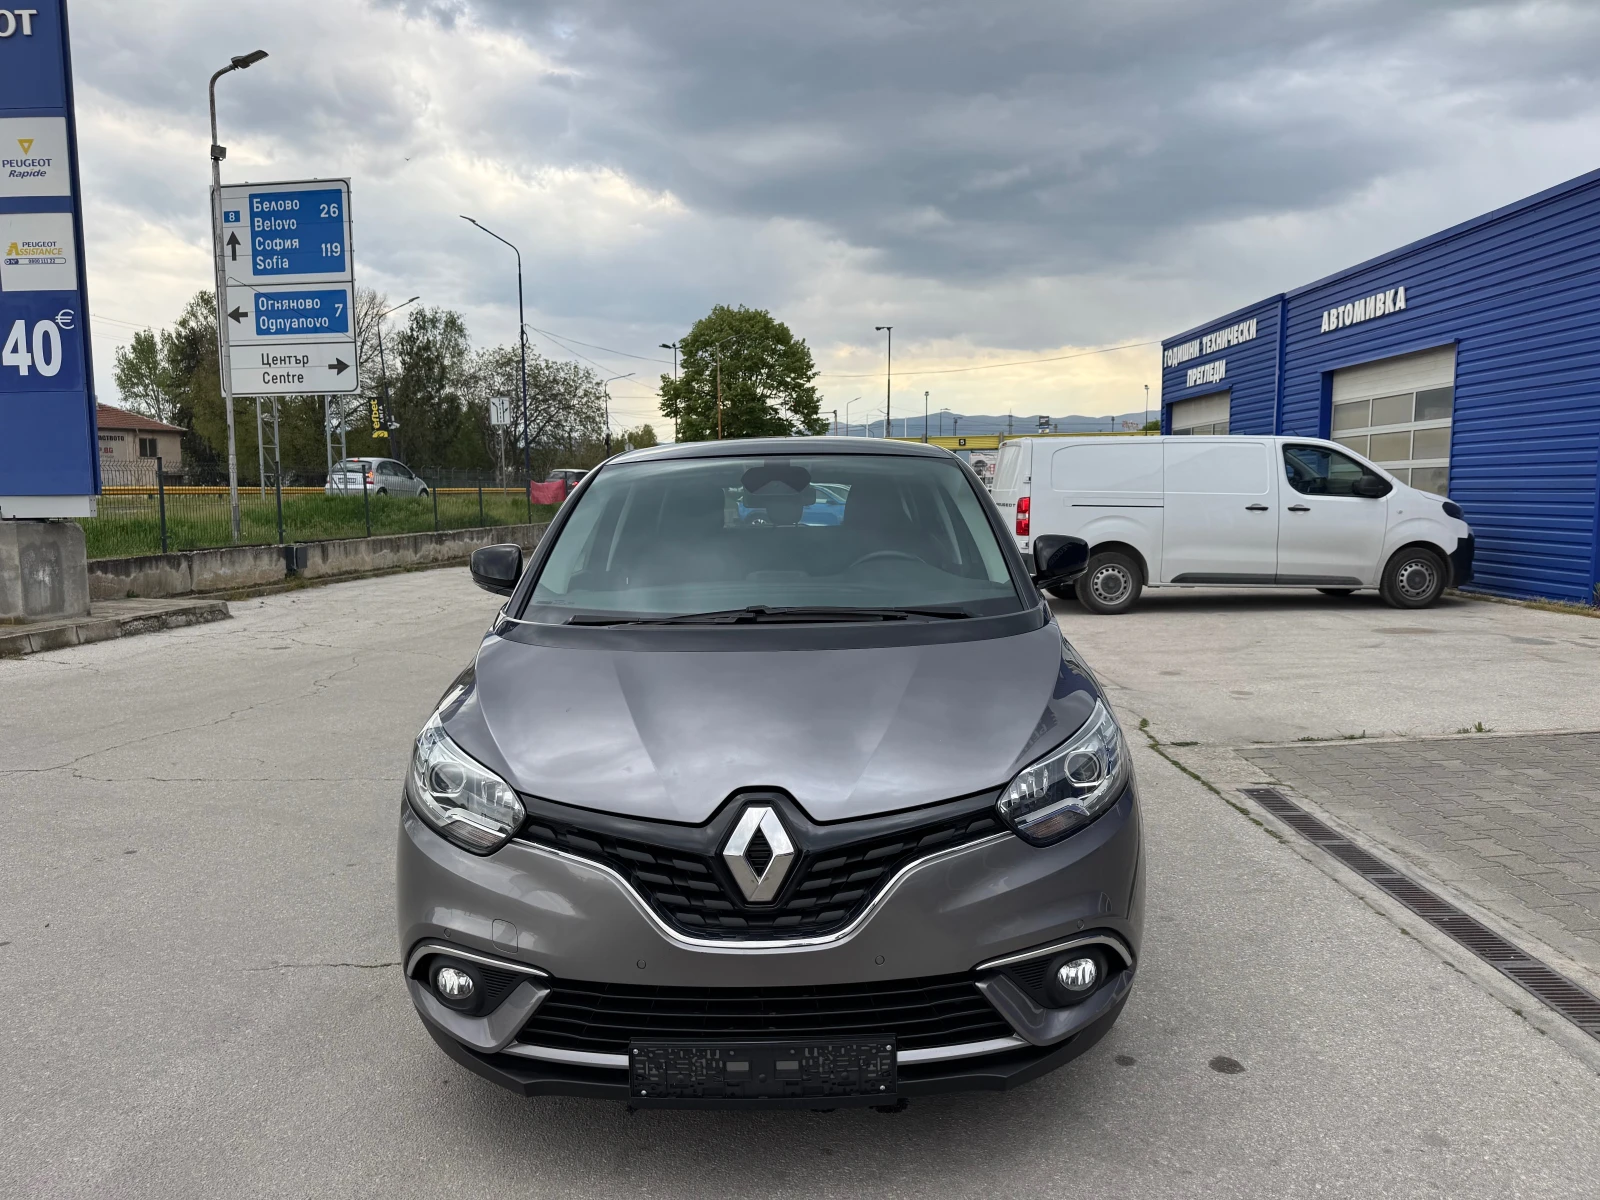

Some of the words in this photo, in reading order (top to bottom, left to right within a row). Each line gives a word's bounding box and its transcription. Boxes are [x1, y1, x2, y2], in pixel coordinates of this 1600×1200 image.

[2, 158, 52, 168] PEUGEOT
[8, 169, 47, 179] Rapide
[253, 199, 300, 212] Белово
[319, 203, 339, 218] 26
[228, 212, 235, 222] 8
[254, 217, 297, 231] Belovo
[255, 237, 299, 251] София
[321, 242, 341, 257] 119
[256, 256, 289, 269] Sofia
[258, 297, 320, 311] Огняново
[334, 303, 343, 318] 7
[1321, 286, 1406, 333] АВТОМИВКА
[260, 316, 329, 333] Ognyanovo
[1164, 339, 1200, 368] ГОДИШНИ
[1202, 317, 1257, 355] ТЕХНИЧЕСКИ
[261, 352, 309, 367] Център
[262, 371, 304, 384] Centre
[1186, 359, 1226, 387] ПРЕГЛЕДИ
[370, 398, 380, 429] efbet
